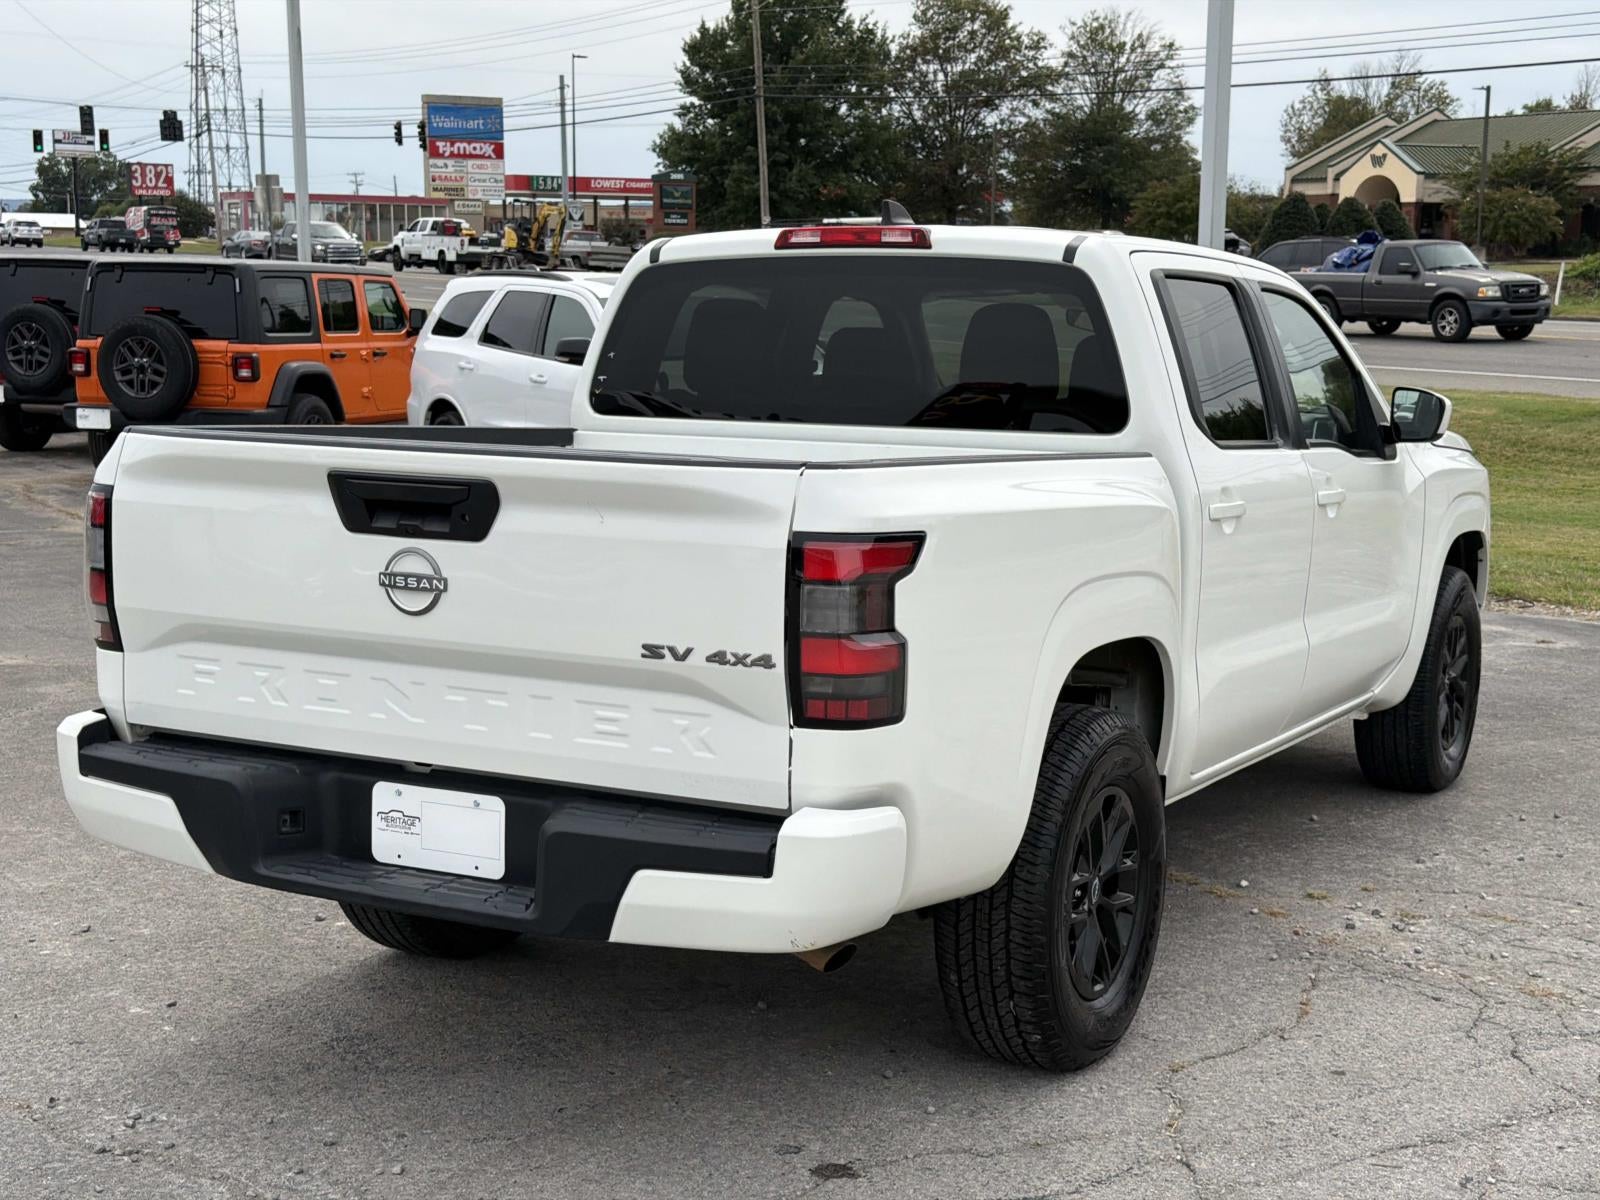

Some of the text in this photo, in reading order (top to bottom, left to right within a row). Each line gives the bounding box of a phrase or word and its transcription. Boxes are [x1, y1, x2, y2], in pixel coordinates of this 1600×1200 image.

[431, 114, 484, 129] Walmart
[591, 179, 625, 188] LOWEST
[380, 574, 444, 590] NISSAN
[640, 643, 695, 662] SV
[176, 654, 717, 758] FRONTIER
[380, 815, 417, 828] HERITAGE
